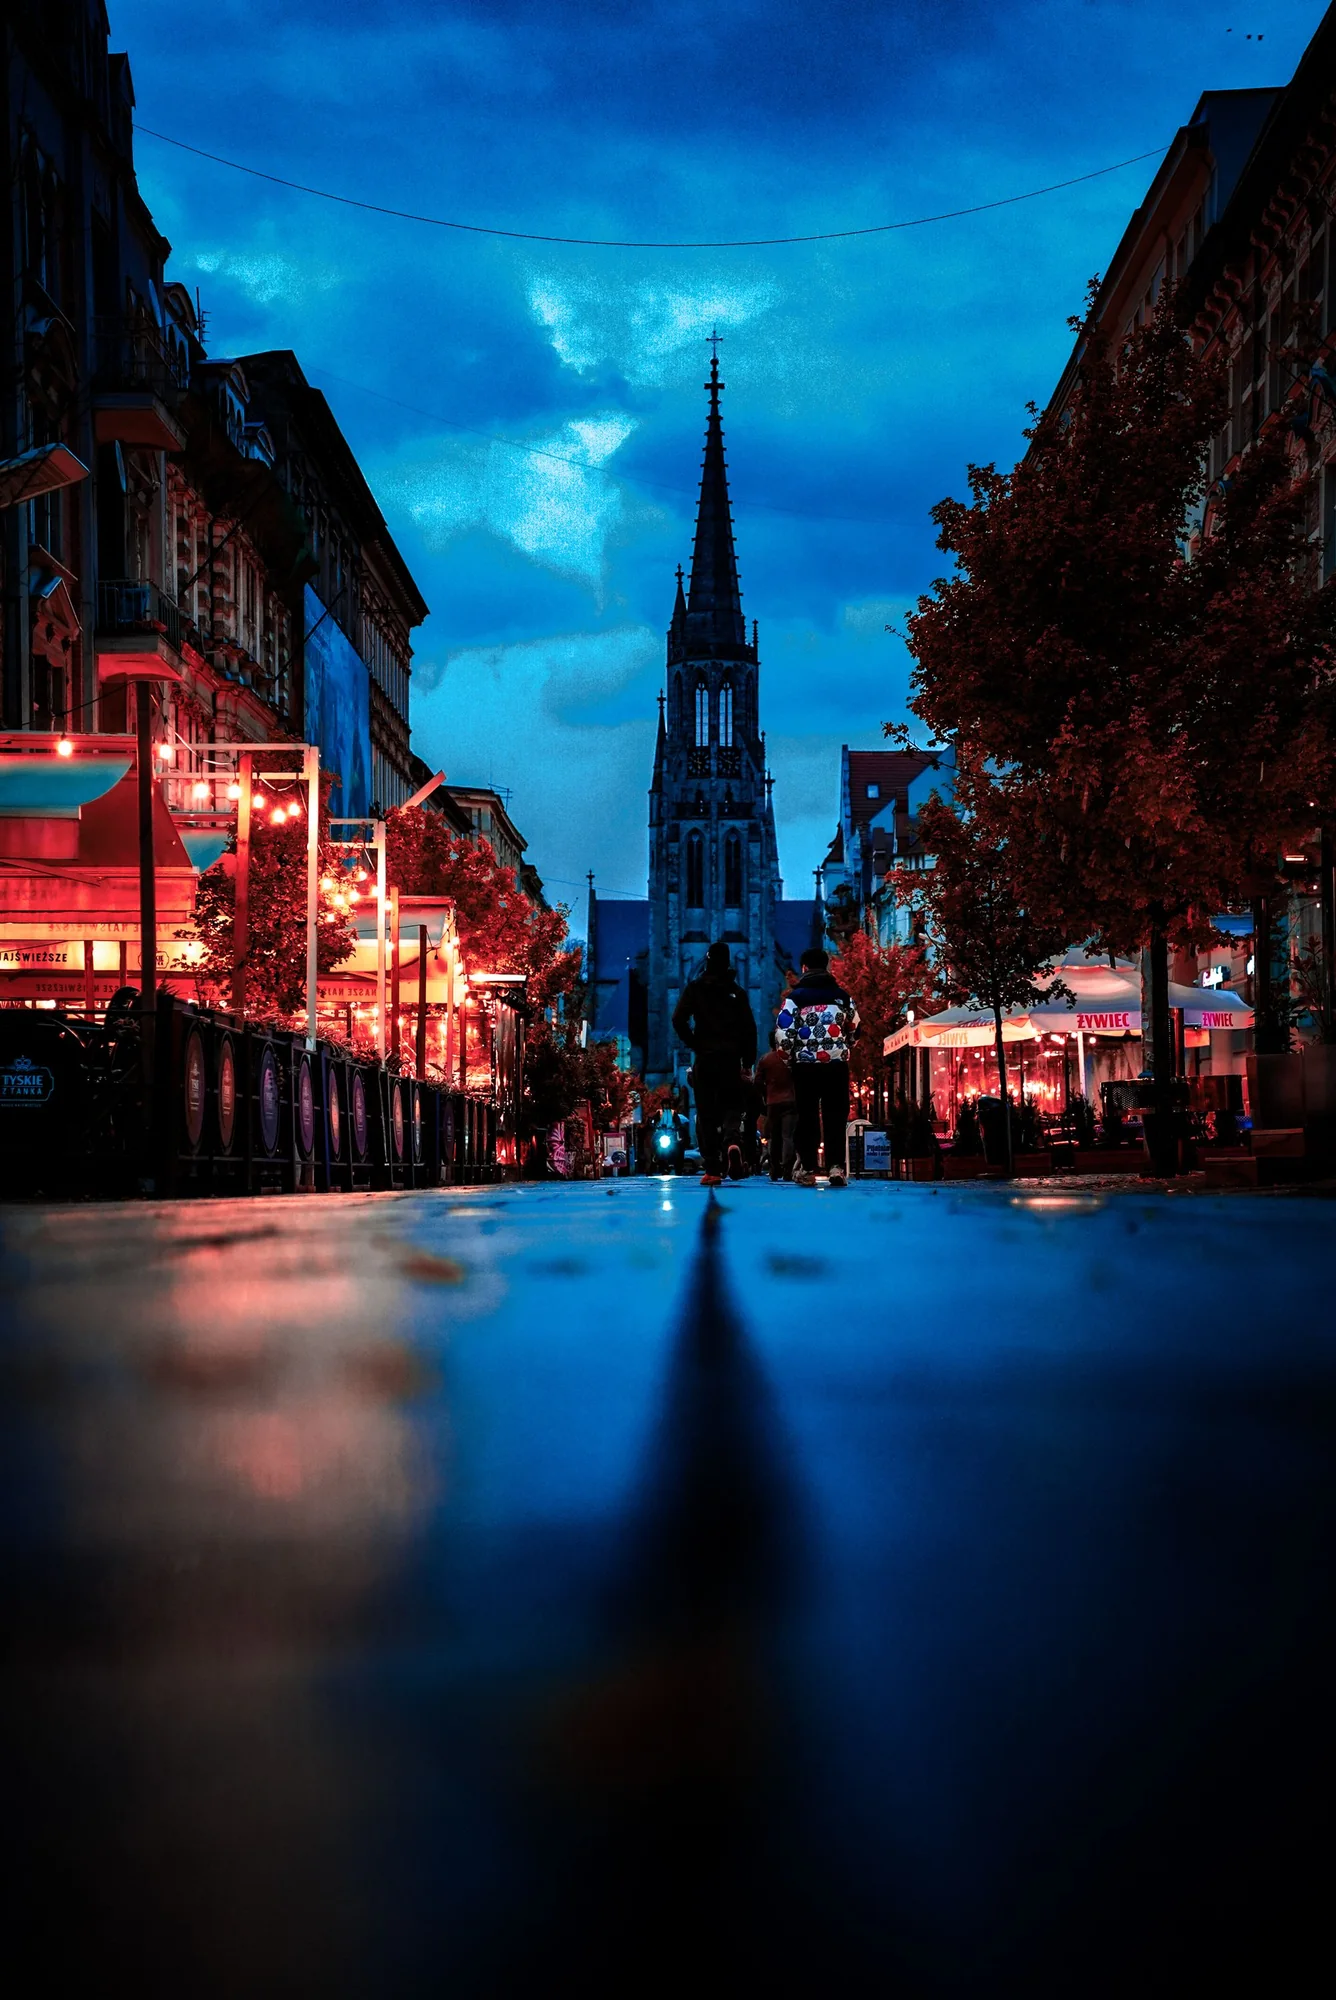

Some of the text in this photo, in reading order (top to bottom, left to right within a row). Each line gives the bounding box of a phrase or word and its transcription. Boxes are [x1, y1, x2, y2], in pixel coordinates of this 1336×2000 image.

[0, 951, 67, 962] AJŚWIEŻSZE
[1076, 1012, 1129, 1029] ŻYWIEC
[1202, 1011, 1233, 1027] ŻYWIEC
[1, 1074, 44, 1086] TYSKIE
